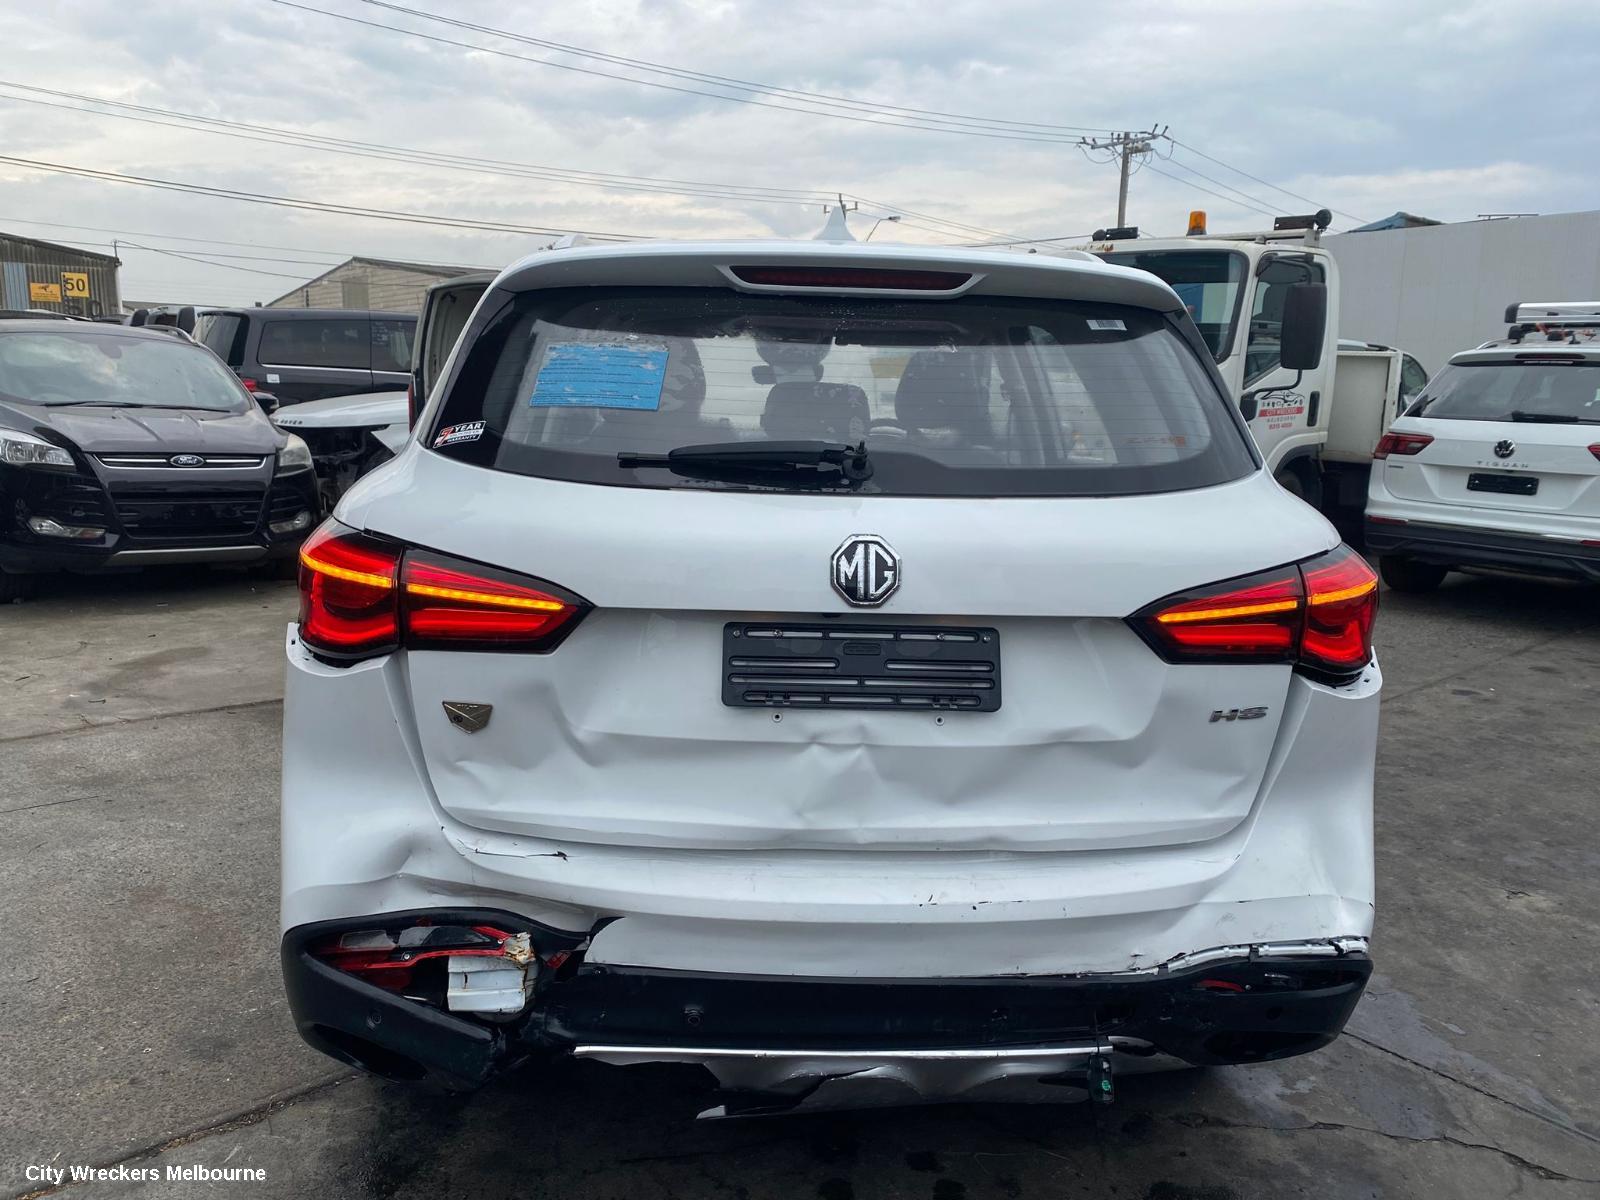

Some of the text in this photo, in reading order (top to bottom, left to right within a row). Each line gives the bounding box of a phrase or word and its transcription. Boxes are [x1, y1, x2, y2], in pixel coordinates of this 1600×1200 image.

[65, 278, 86, 292] 50
[455, 423, 481, 432] YEAR
[1477, 460, 1529, 468] TIGUAN
[837, 542, 896, 600] MG
[1209, 706, 1269, 722] HS
